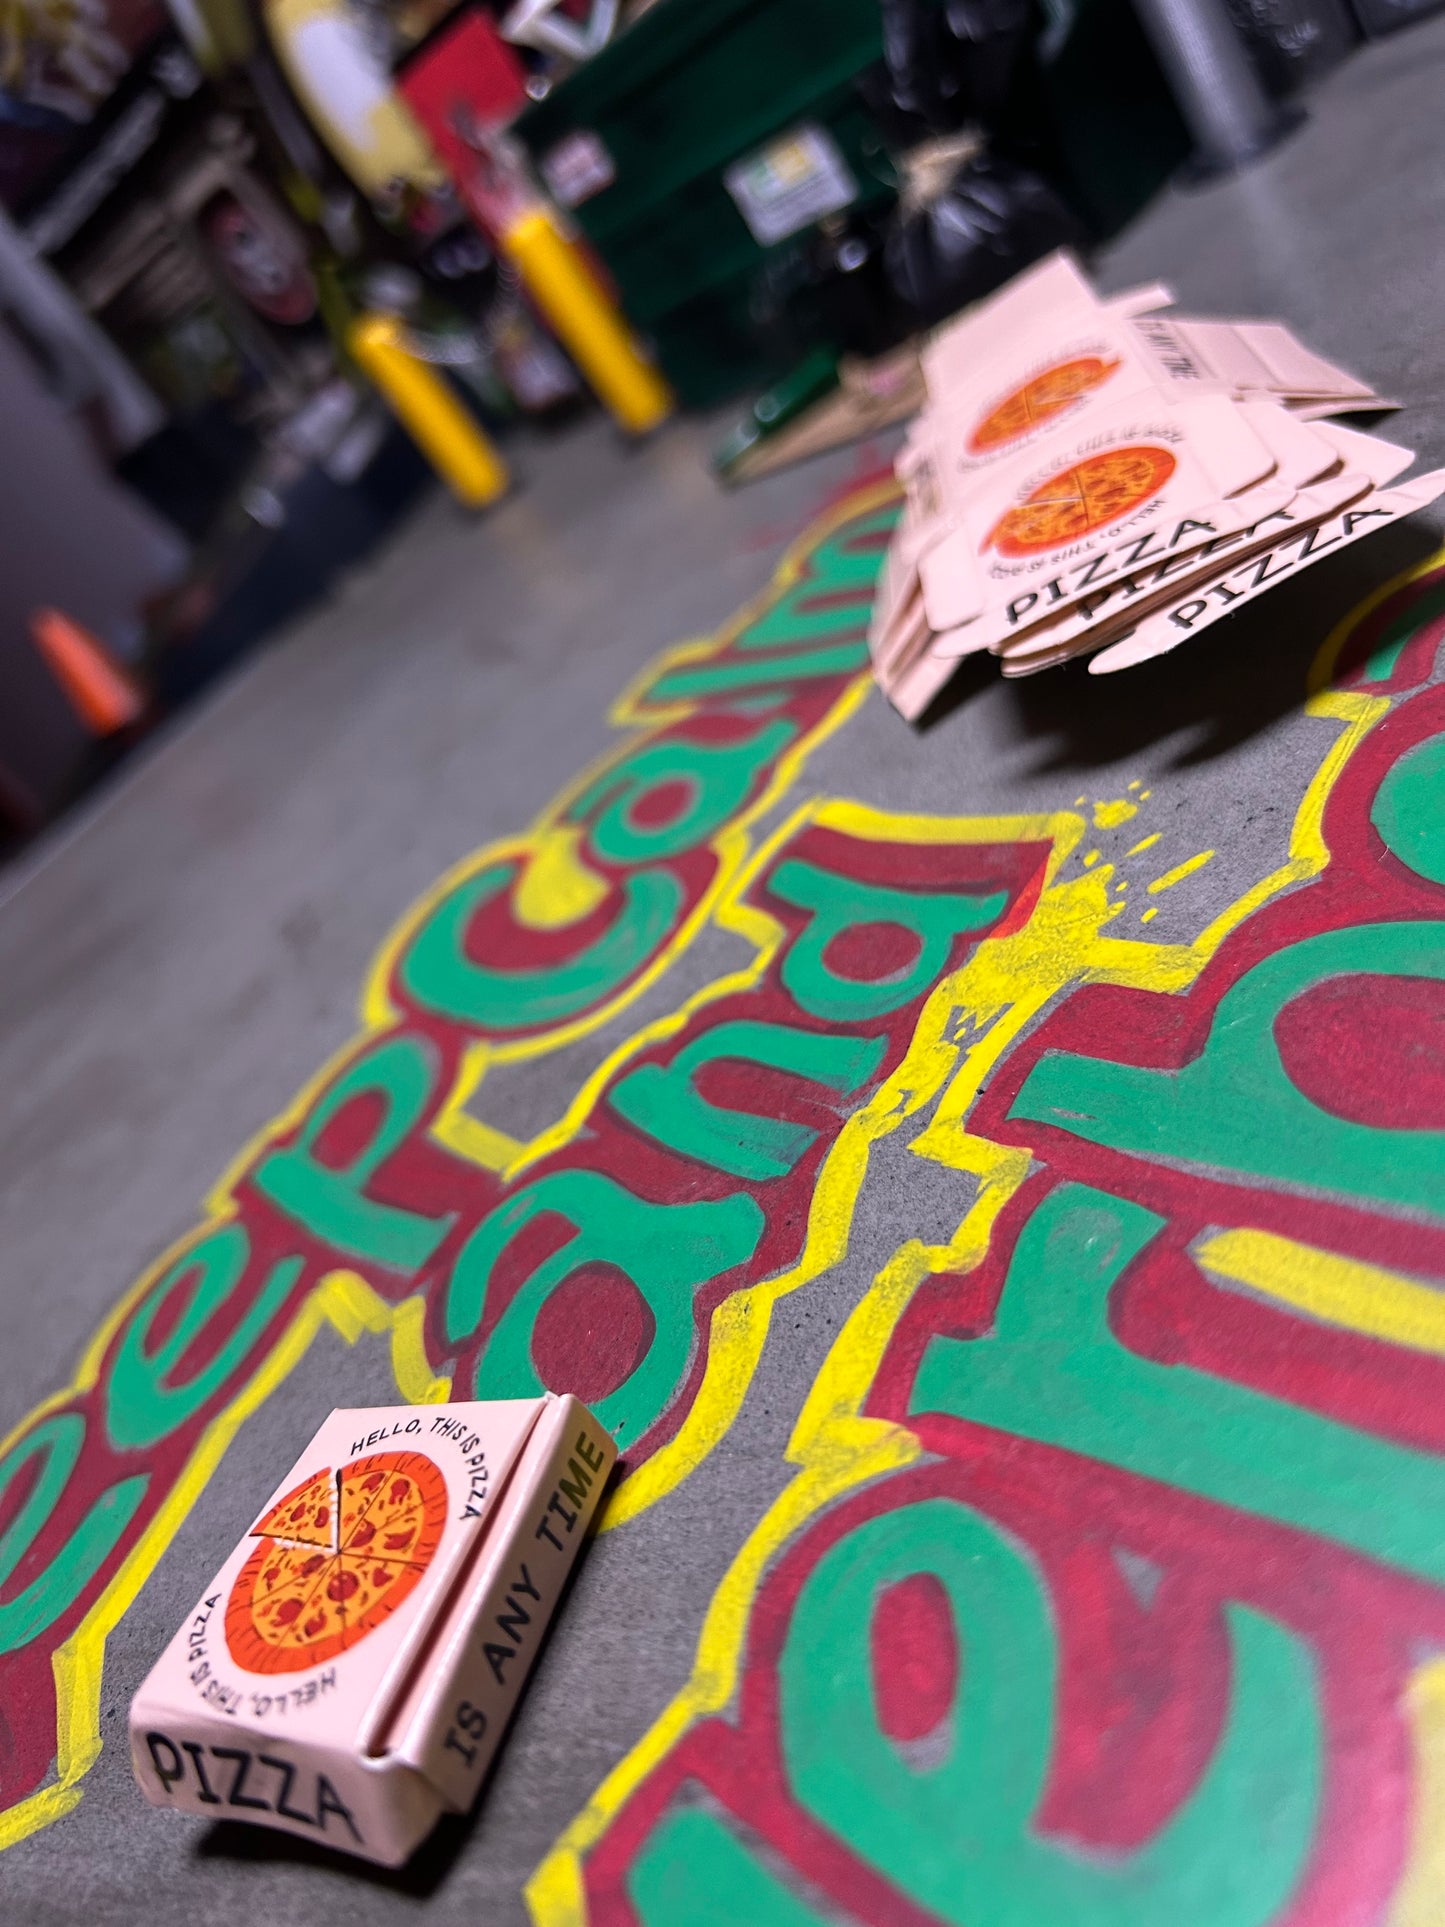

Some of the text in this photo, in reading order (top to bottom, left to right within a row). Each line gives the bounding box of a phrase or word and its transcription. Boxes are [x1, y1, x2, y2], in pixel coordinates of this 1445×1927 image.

[1004, 518, 1217, 626] PIZZA
[1167, 504, 1394, 630] PIZZA
[350, 1416, 489, 1520] HELLO, THIS IS PIZZA
[188, 1592, 337, 1717] HELLO, THIS IS PIZZA
[443, 1431, 607, 1769] IS ANY TIME
[146, 1731, 365, 1844] PIZZA
